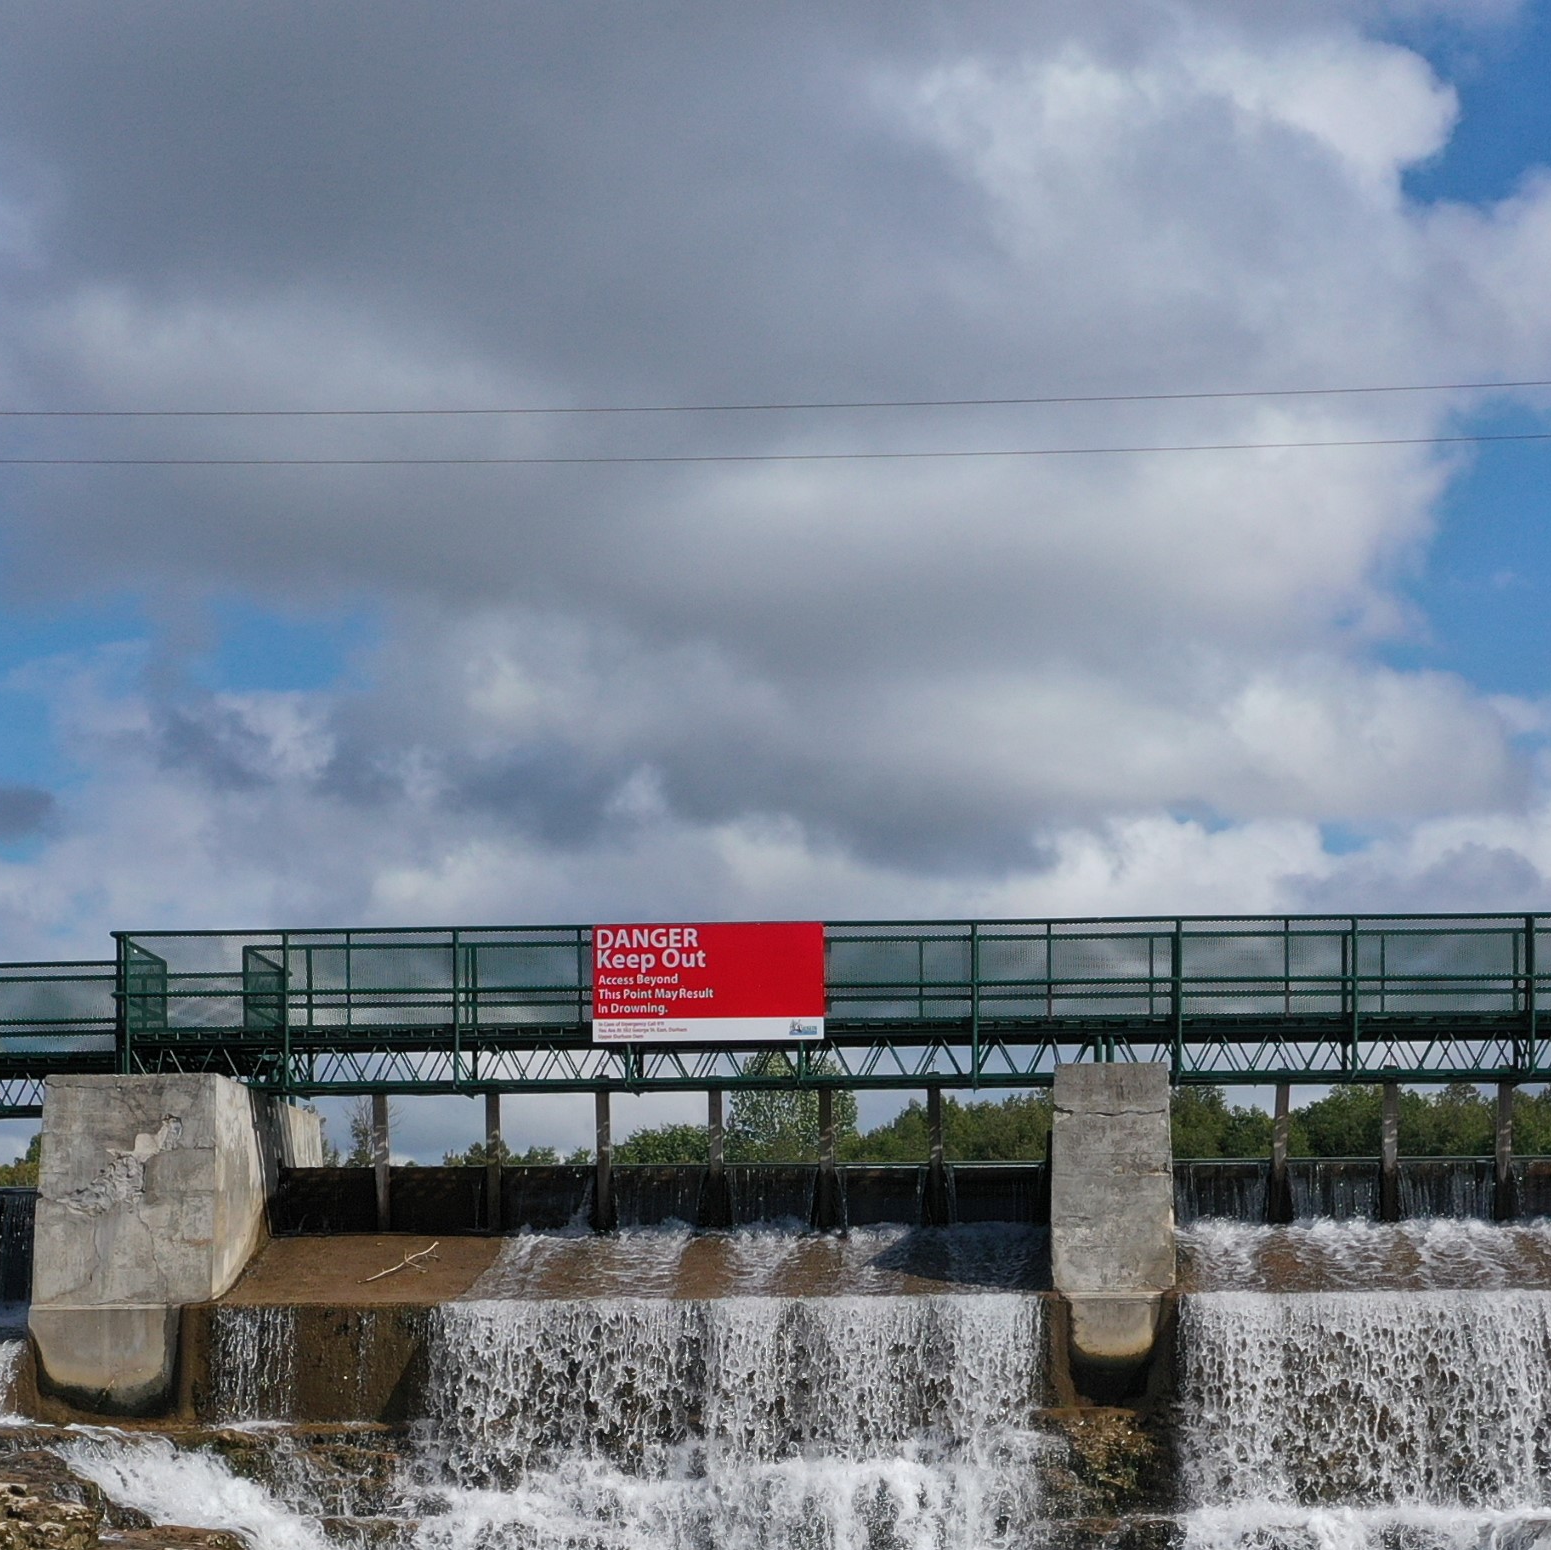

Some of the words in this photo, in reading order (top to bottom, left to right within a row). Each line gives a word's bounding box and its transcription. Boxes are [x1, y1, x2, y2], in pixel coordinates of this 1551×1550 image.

[596, 928, 698, 949] DANGER
[597, 949, 656, 974] Keep
[661, 948, 706, 968] Out
[598, 974, 634, 985] Access
[636, 973, 679, 987] Beyond
[598, 988, 621, 999] This
[623, 988, 652, 999] Point
[654, 988, 678, 1001] May
[679, 987, 714, 998] Result
[597, 1003, 608, 1013] In
[610, 1002, 668, 1016] Drowning.
